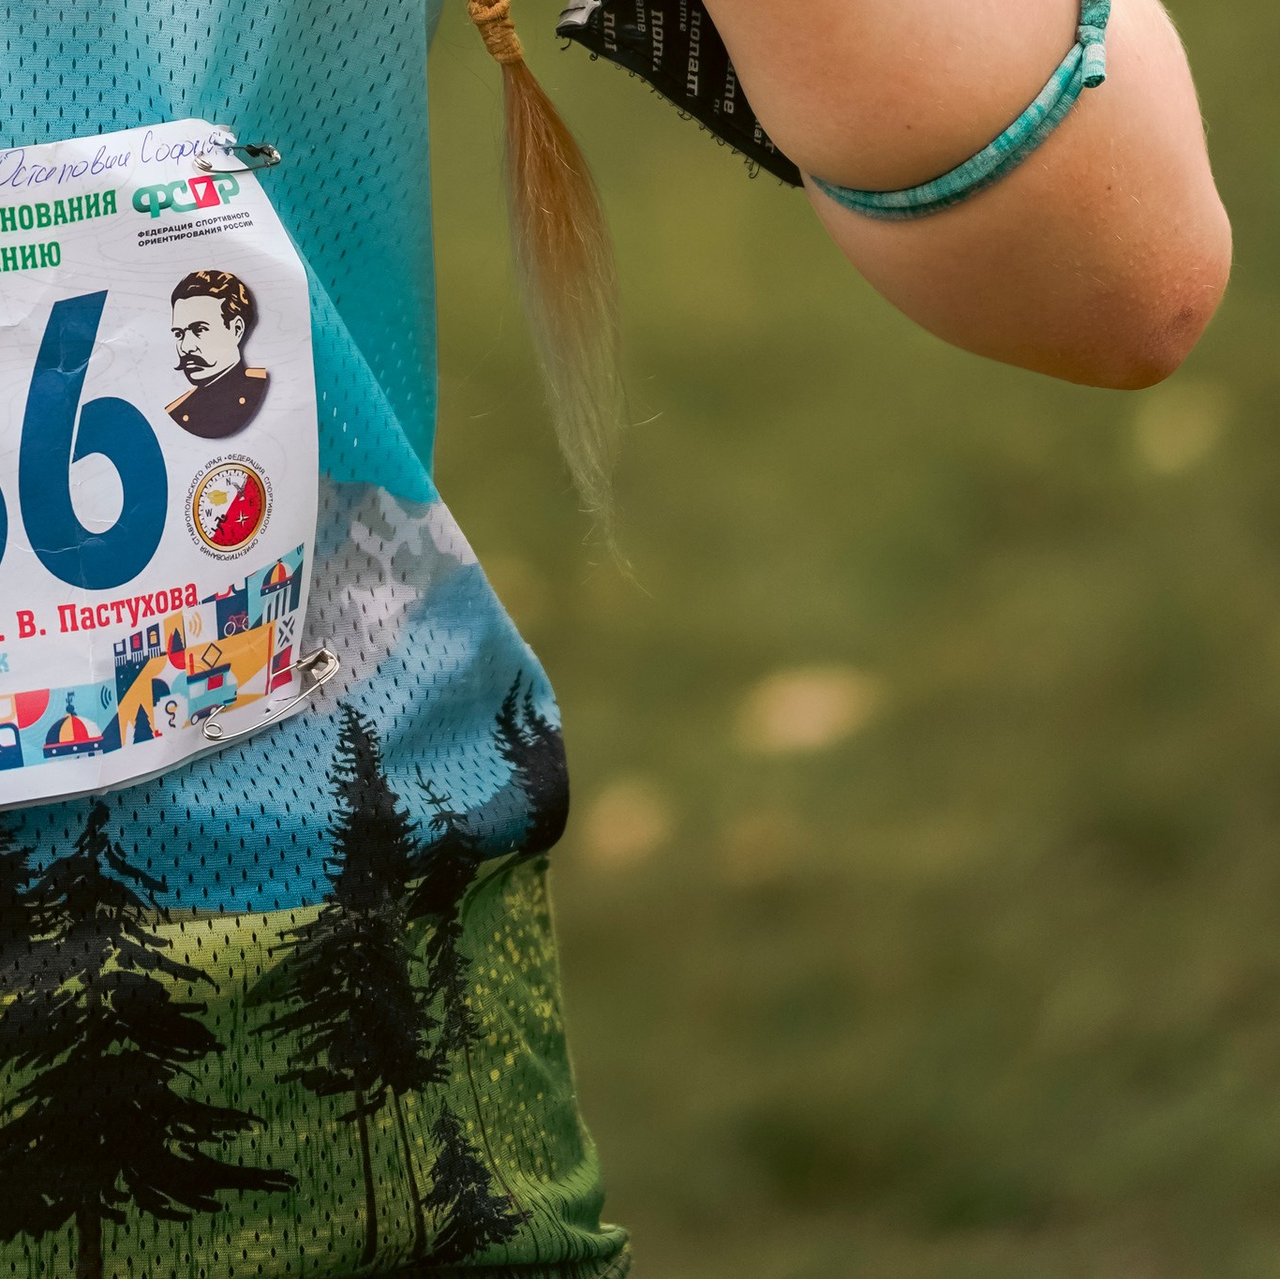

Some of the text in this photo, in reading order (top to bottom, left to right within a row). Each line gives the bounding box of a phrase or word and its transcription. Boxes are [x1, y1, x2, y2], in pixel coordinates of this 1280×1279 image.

[686, 10, 702, 98] nonam
[137, 211, 250, 238] ФЕДЕРАЦИЯ СПОРТИВНОГО
[138, 220, 254, 248] ОРИЕНТИРОВАНИЯ РОССИИ
[184, 453, 274, 561] ФЕДЕРАЦИЯ СПОРТИВНОГО ОРИЕНТИРОВАНИЯ СТАВРОПОЛЬСКОГО КРАЯ
[16, 609, 47, 639] В.
[57, 583, 198, 633] Пастухова
